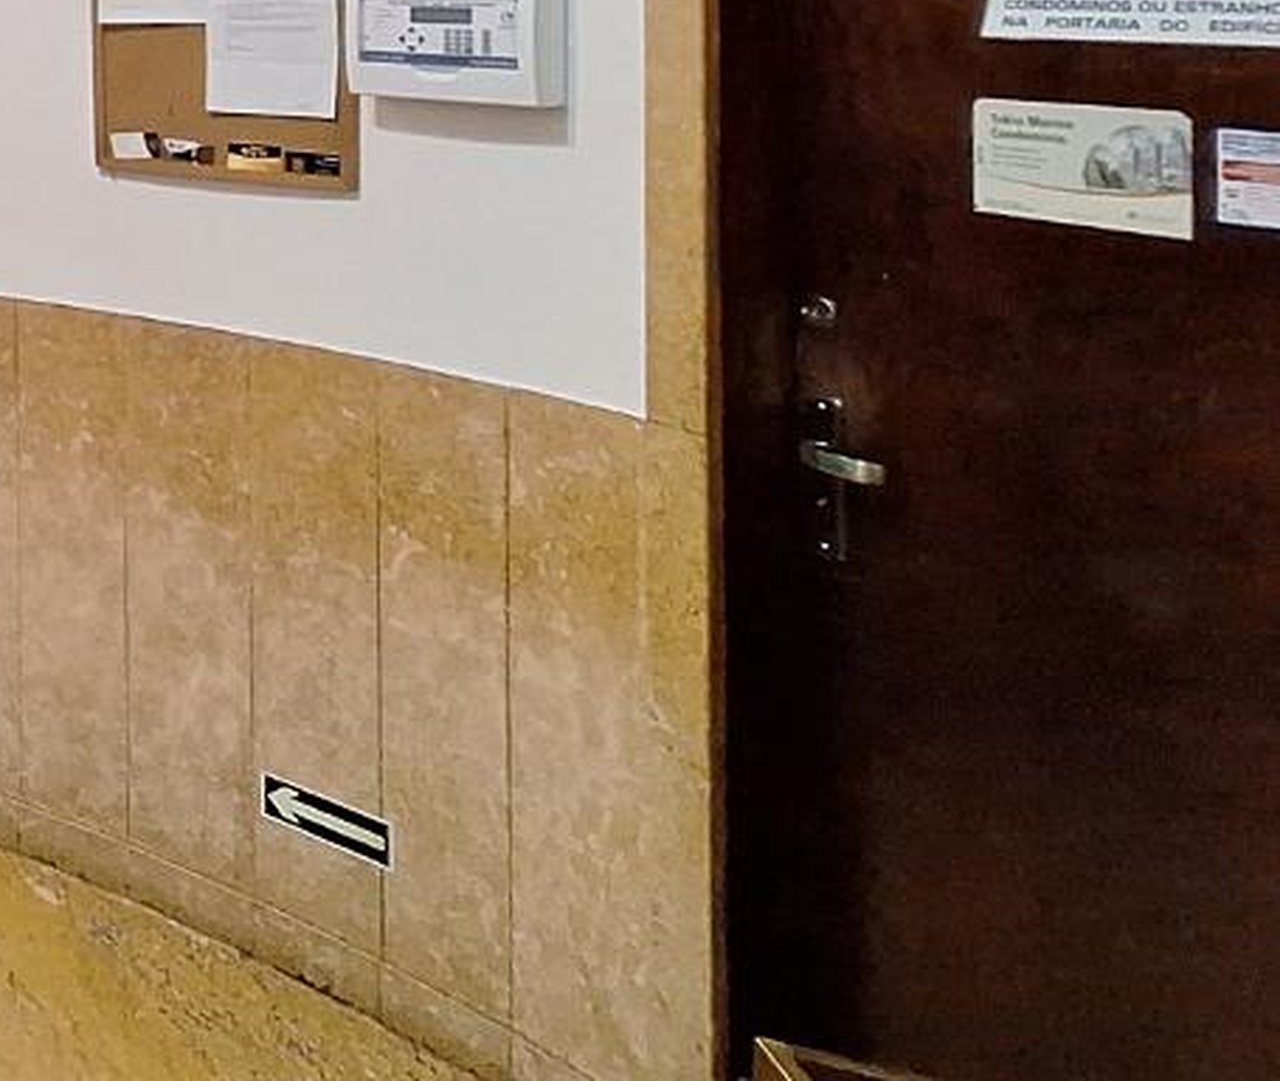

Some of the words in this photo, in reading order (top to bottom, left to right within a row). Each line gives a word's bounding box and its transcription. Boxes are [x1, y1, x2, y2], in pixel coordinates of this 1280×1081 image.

[1138, 0, 1167, 13] OU
[1045, 17, 1141, 31] PORTARIA
[1160, 19, 1189, 32] DO
